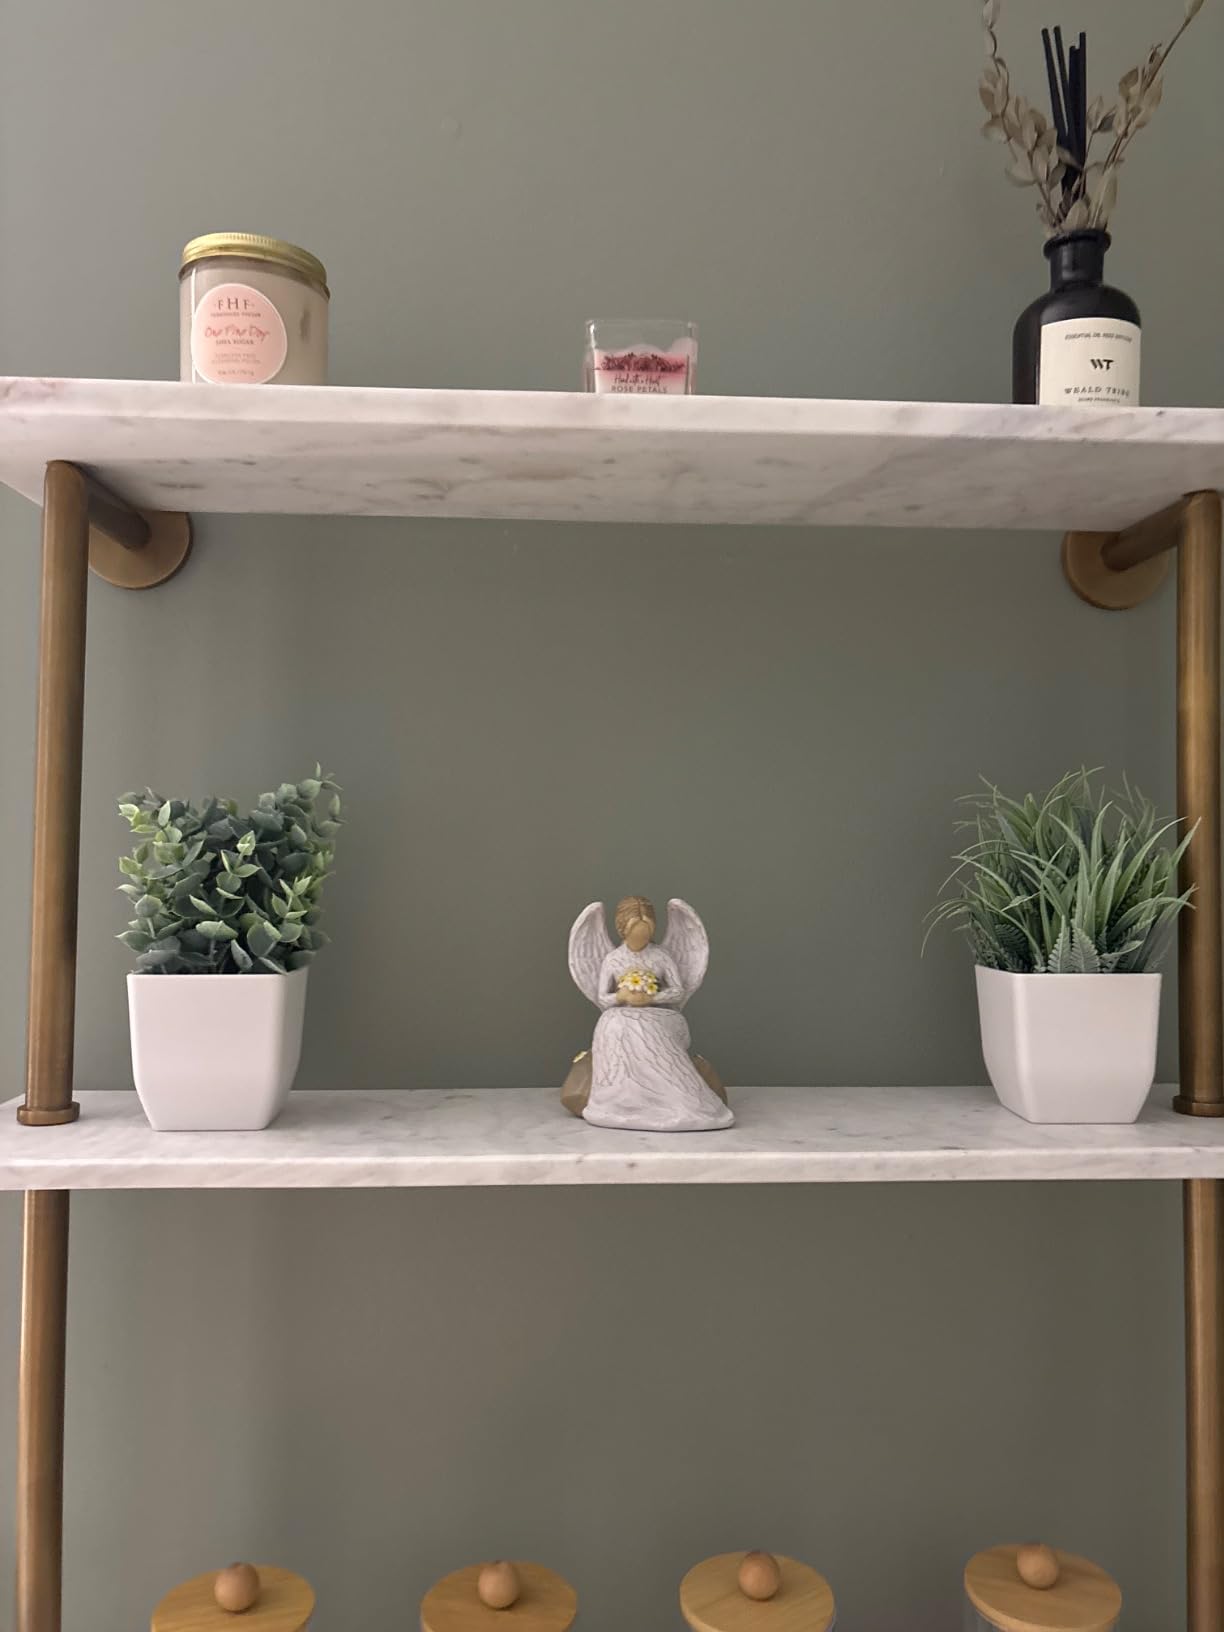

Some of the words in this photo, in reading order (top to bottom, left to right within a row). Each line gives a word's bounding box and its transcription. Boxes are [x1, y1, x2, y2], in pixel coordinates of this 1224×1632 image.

[611, 385, 634, 393] ROSE
[637, 385, 668, 394] PETALS
[1064, 386, 1102, 395] WEALD
